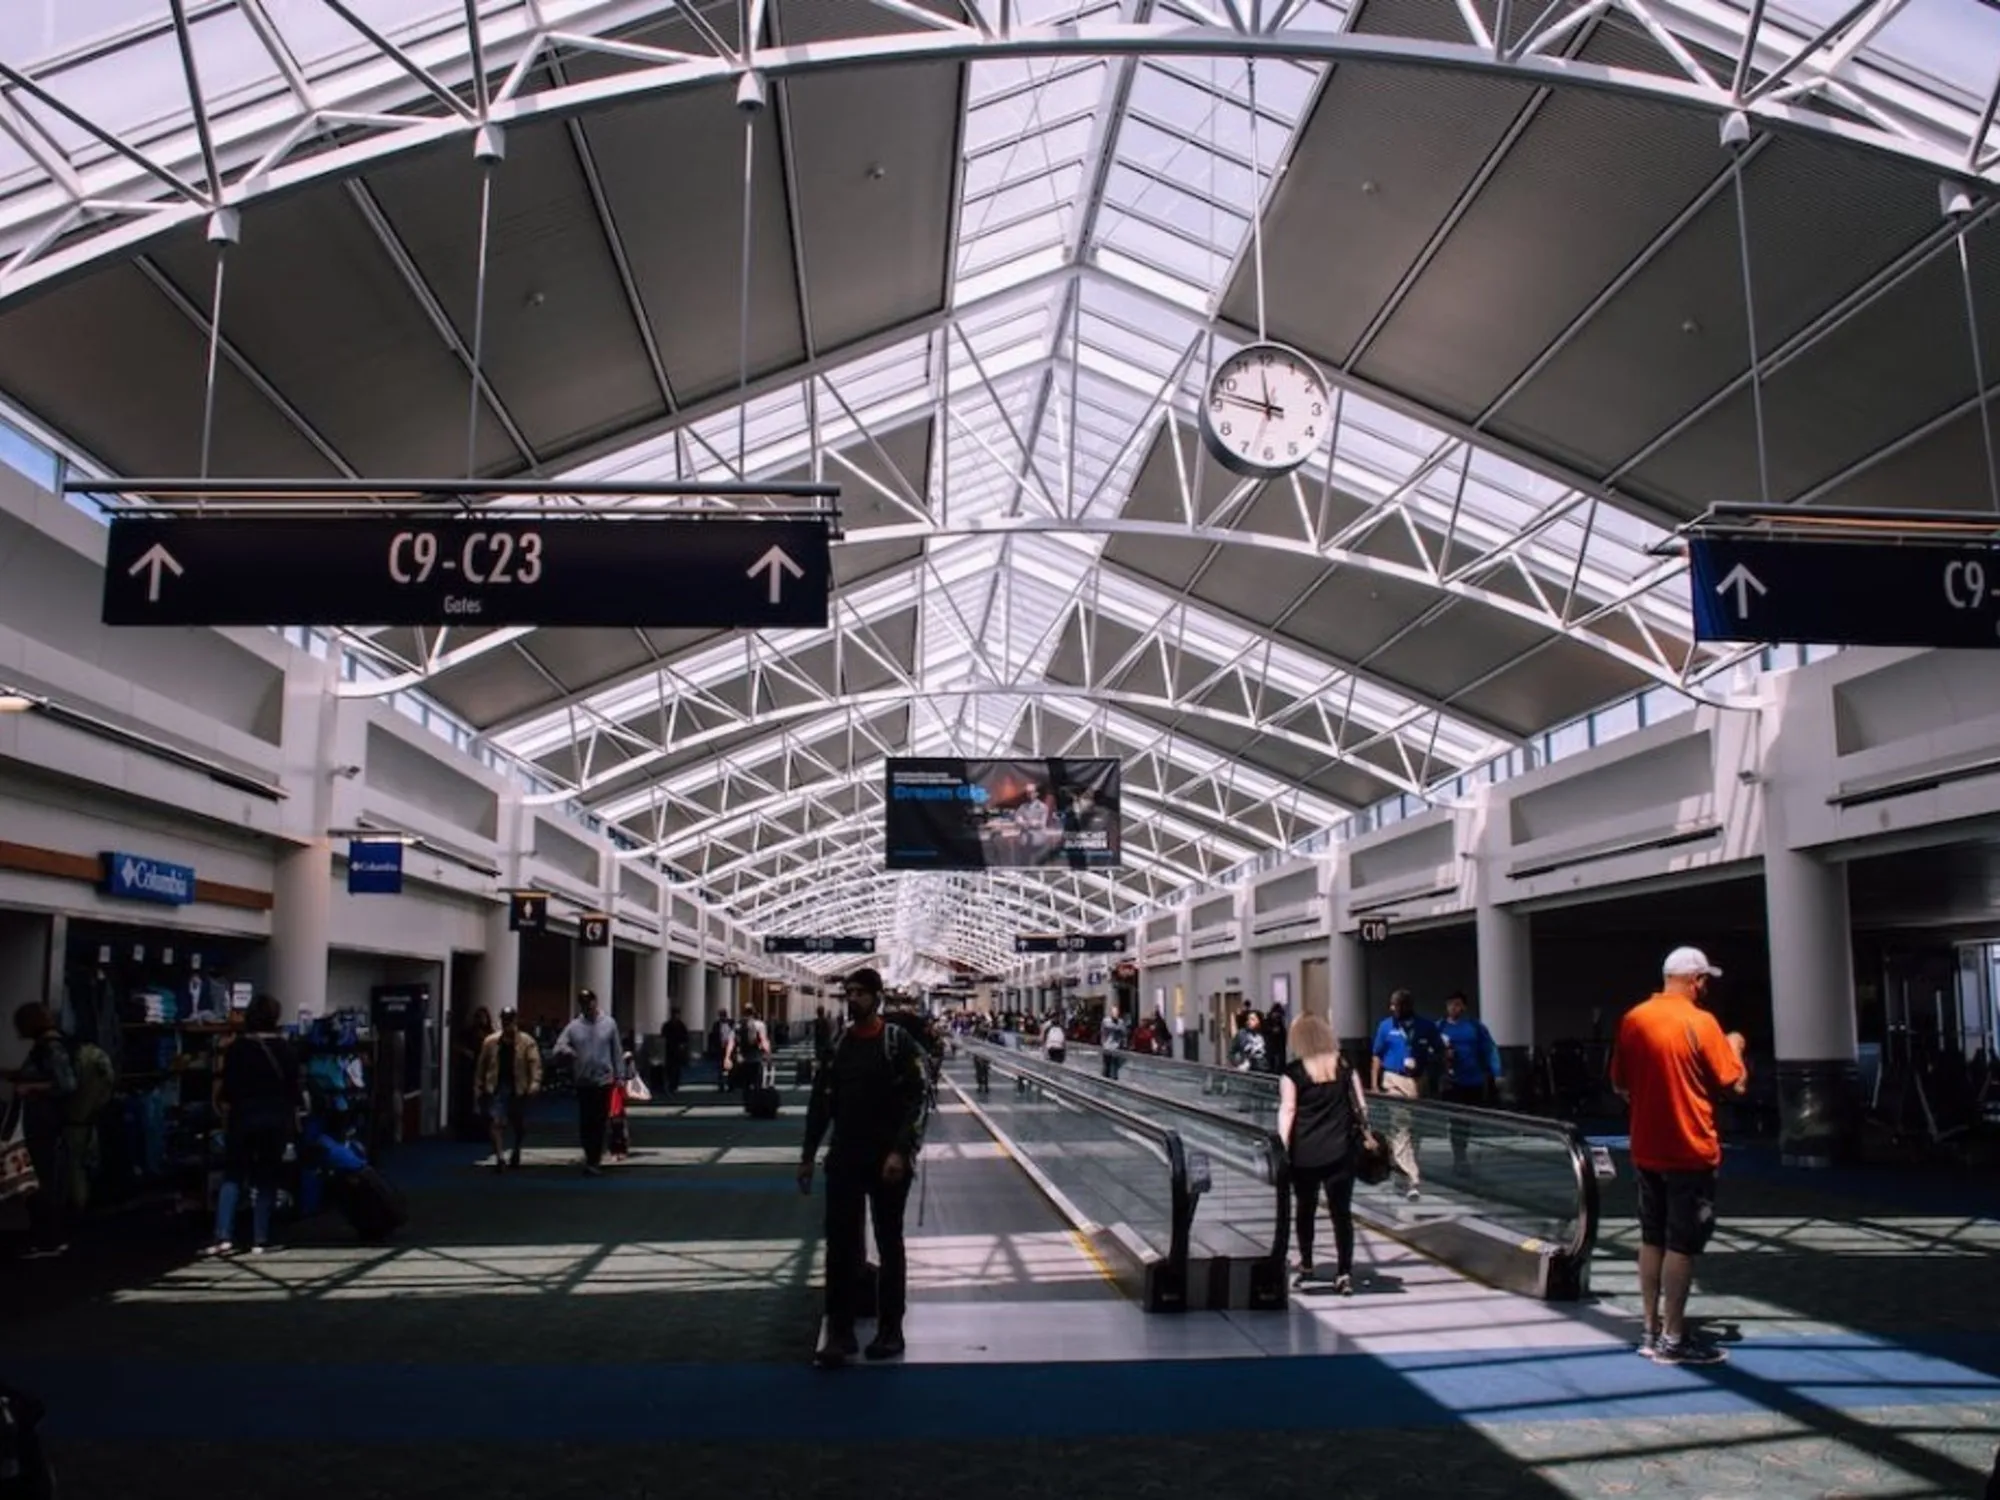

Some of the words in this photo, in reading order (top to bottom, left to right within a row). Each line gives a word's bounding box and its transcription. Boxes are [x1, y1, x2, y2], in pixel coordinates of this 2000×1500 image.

[1258, 353, 1274, 366] 12
[1304, 379, 1314, 394] 2
[1311, 402, 1322, 417] 3
[1220, 422, 1232, 436] 8
[1305, 425, 1315, 438] 4
[1241, 441, 1250, 453] 7
[1263, 446, 1274, 461] 6
[1287, 441, 1298, 455] 5
[388, 532, 542, 584] C9-C23
[444, 595, 482, 613] Gates
[136, 862, 186, 896] Columbia
[1363, 923, 1386, 942] C10
